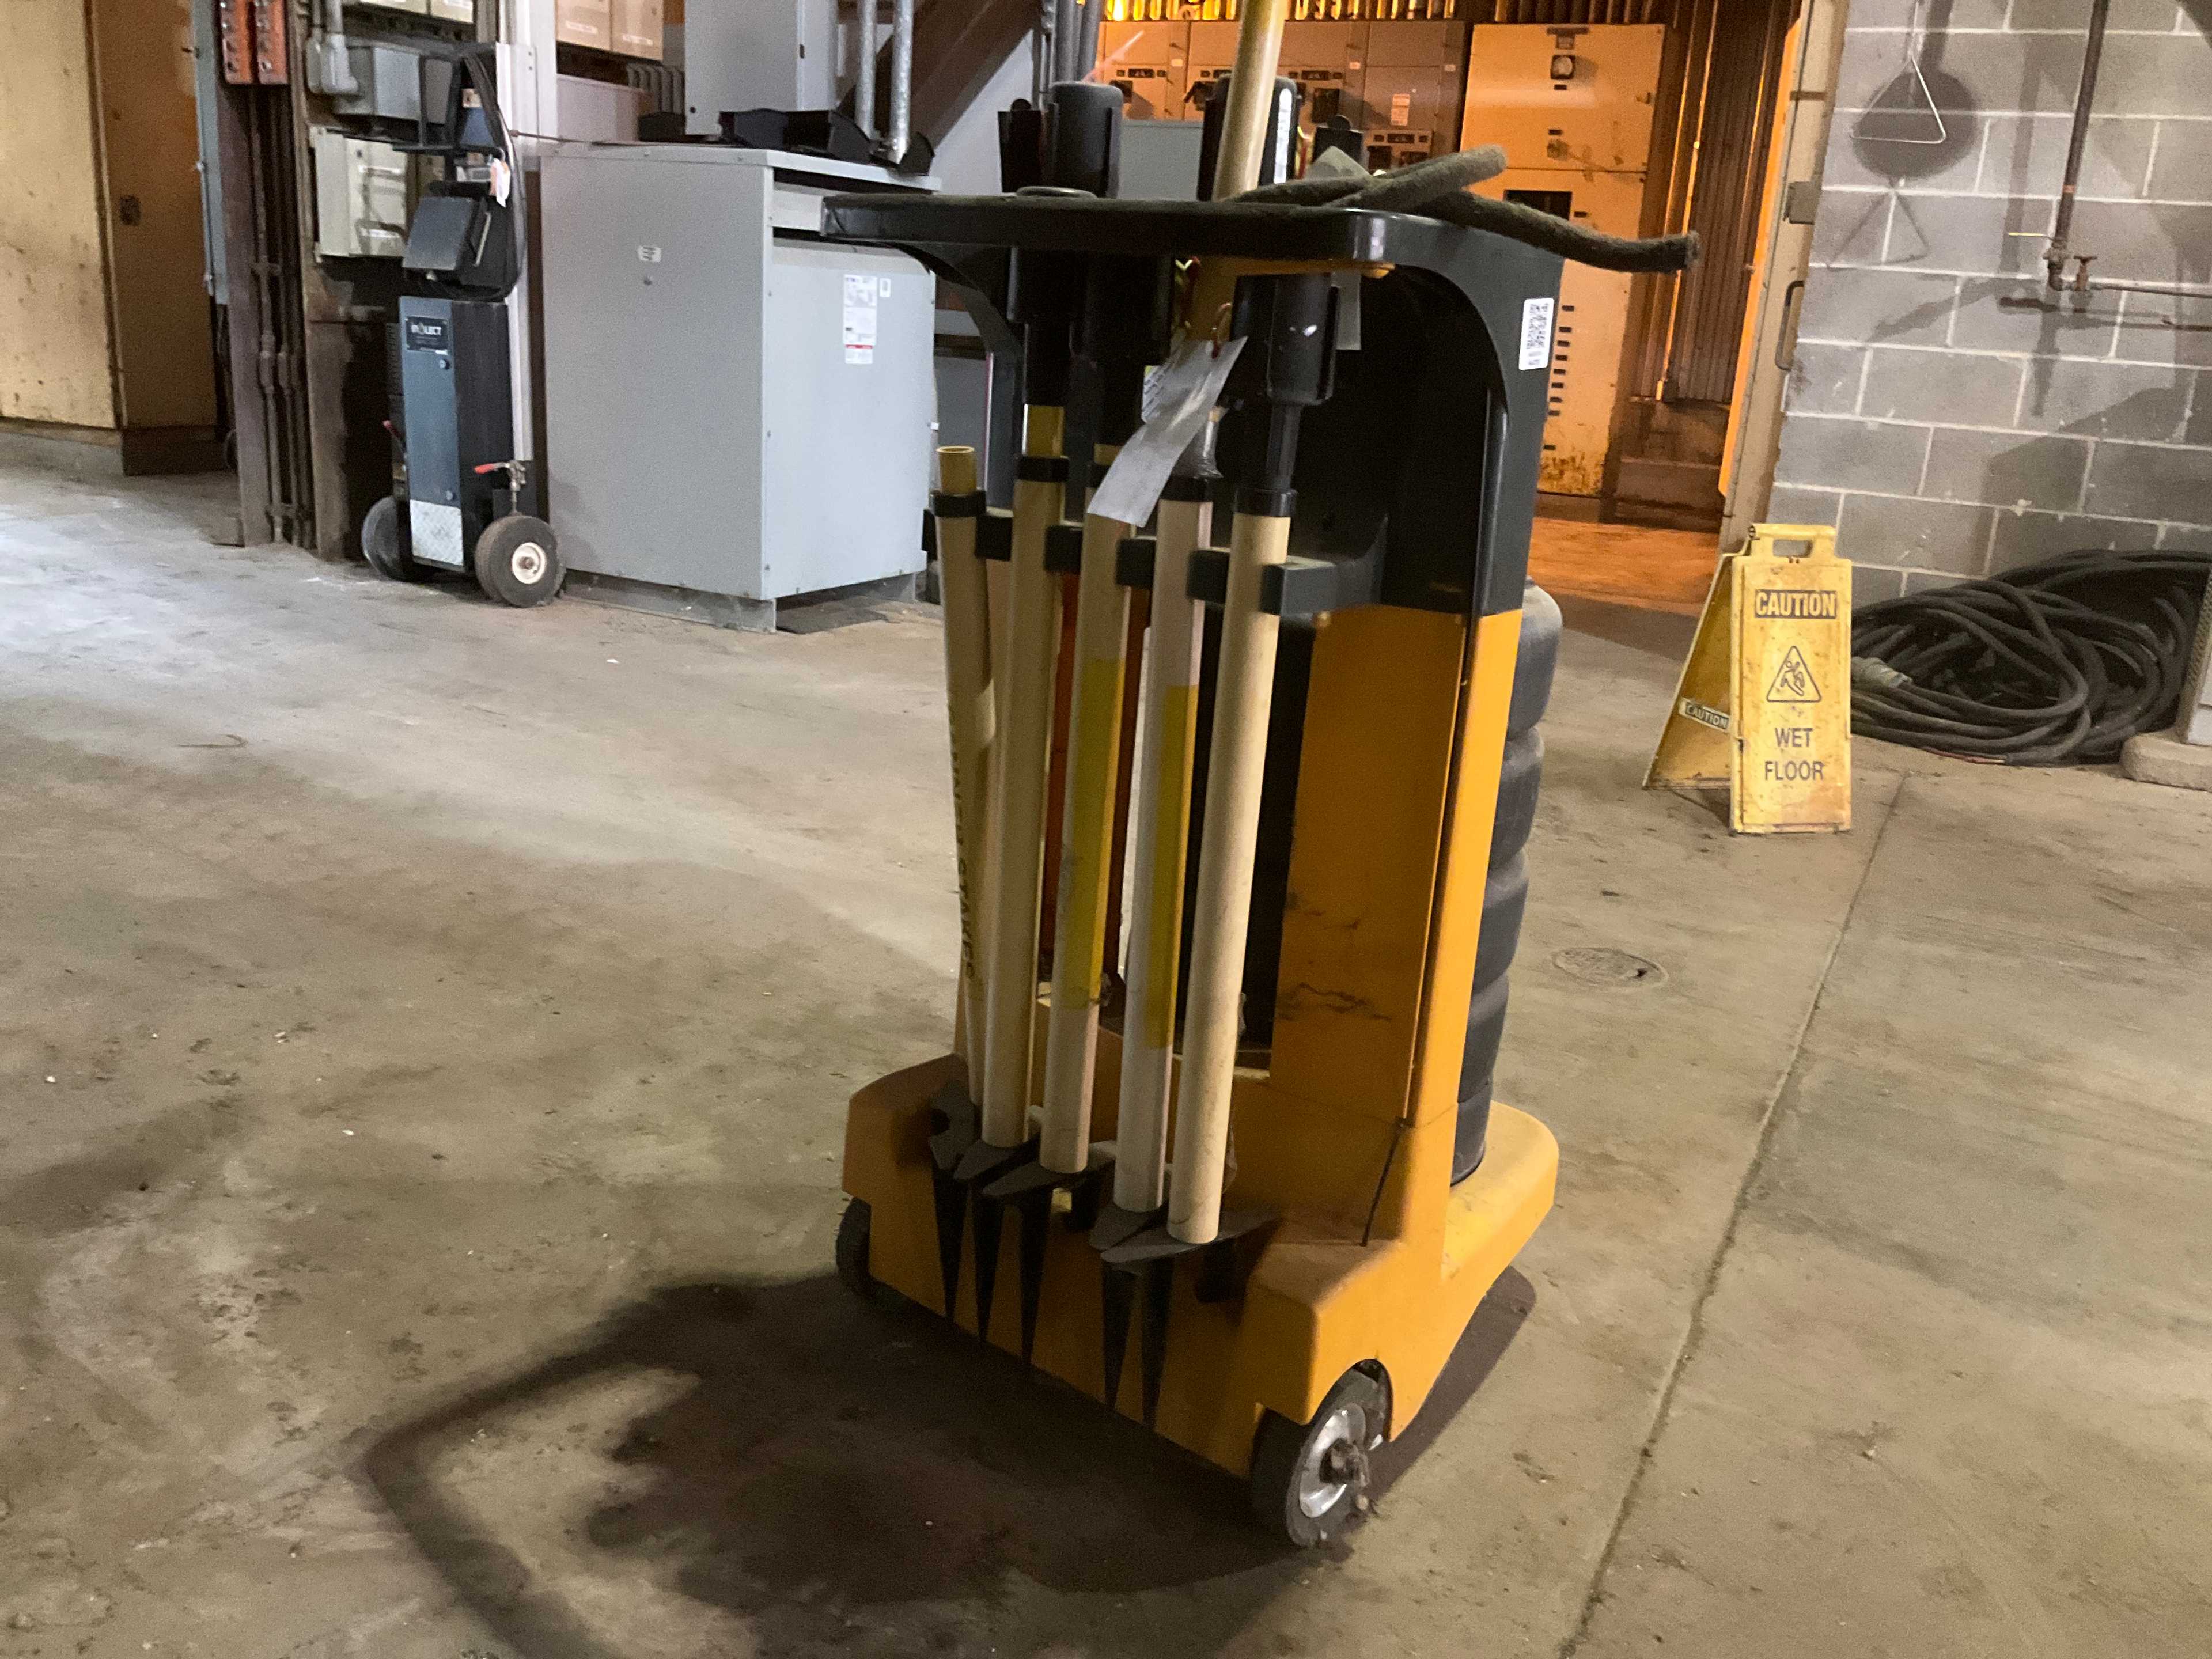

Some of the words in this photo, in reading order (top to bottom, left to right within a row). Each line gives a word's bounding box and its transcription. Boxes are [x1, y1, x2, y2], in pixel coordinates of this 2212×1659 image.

[1756, 592, 1836, 617] CAUTION
[1774, 728, 1813, 747] WET
[1764, 760, 1825, 781] FLOOR
